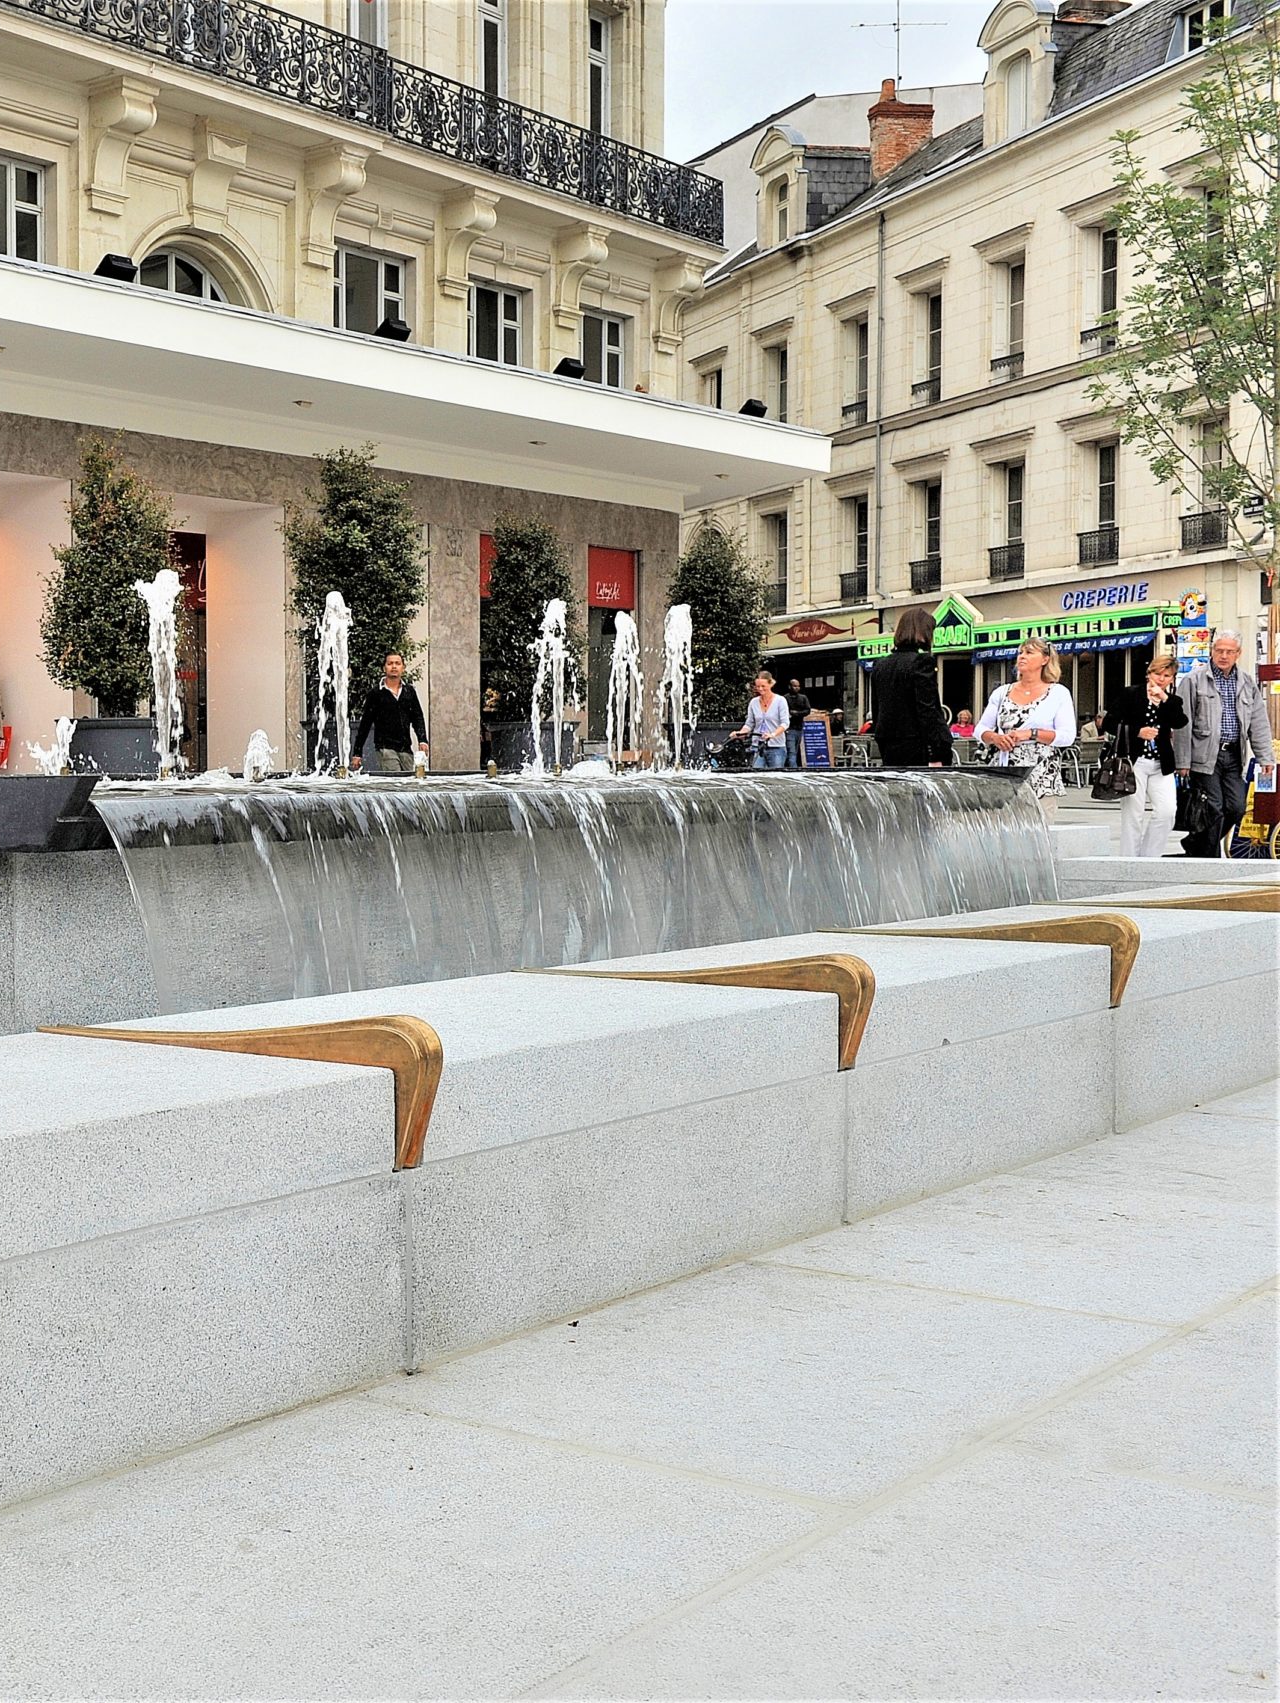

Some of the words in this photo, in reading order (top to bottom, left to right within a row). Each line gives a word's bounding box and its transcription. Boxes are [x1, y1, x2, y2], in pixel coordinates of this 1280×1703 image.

[1062, 582, 1149, 610] CREPERIE
[988, 630, 1007, 643] DU
[1020, 618, 1121, 640] RALLIEMENT
[1163, 615, 1182, 628] CREP
[933, 624, 968, 646] BAR
[863, 642, 896, 655] CREP
